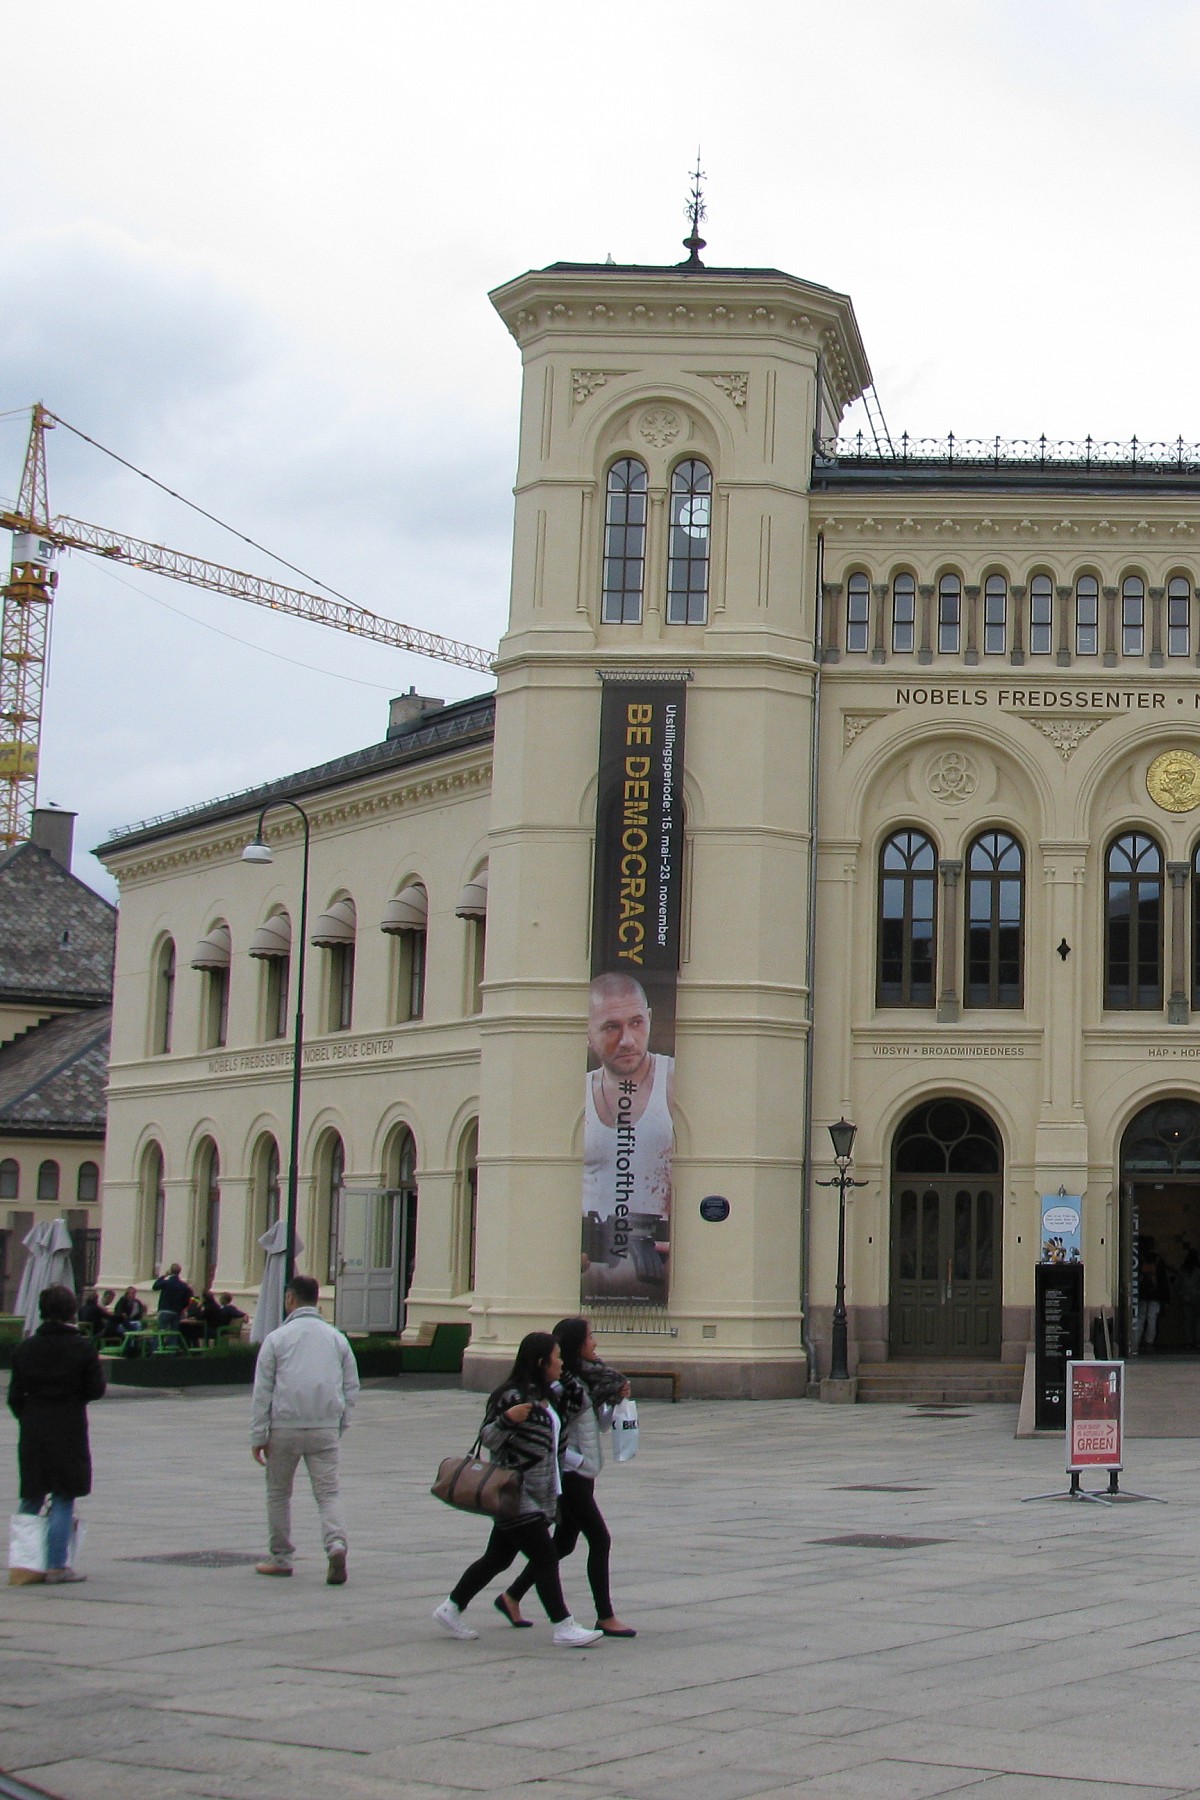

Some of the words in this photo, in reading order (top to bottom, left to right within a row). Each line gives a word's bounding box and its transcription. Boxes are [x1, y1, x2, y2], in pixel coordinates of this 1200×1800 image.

[896, 688, 988, 706] NOBELS
[998, 690, 1166, 709] FREDSSENTER
[625, 704, 653, 746] BE
[662, 704, 677, 812] Utstillingsperiode:
[661, 815, 672, 832] 15.
[617, 756, 652, 966] DEMOCRACY
[657, 885, 670, 946] november
[208, 1057, 238, 1074] NOBELS
[303, 1047, 331, 1064] NOBEL
[332, 1043, 359, 1060] PEACE
[360, 1039, 394, 1056] CENTER
[872, 1046, 910, 1056] VIDSYN
[921, 1046, 1025, 1057] BROADMINDEDNESS
[1148, 1047, 1169, 1057] HÅP
[610, 1079, 638, 1260] #outfitoftheday
[1077, 1437, 1114, 1451] GREEN
